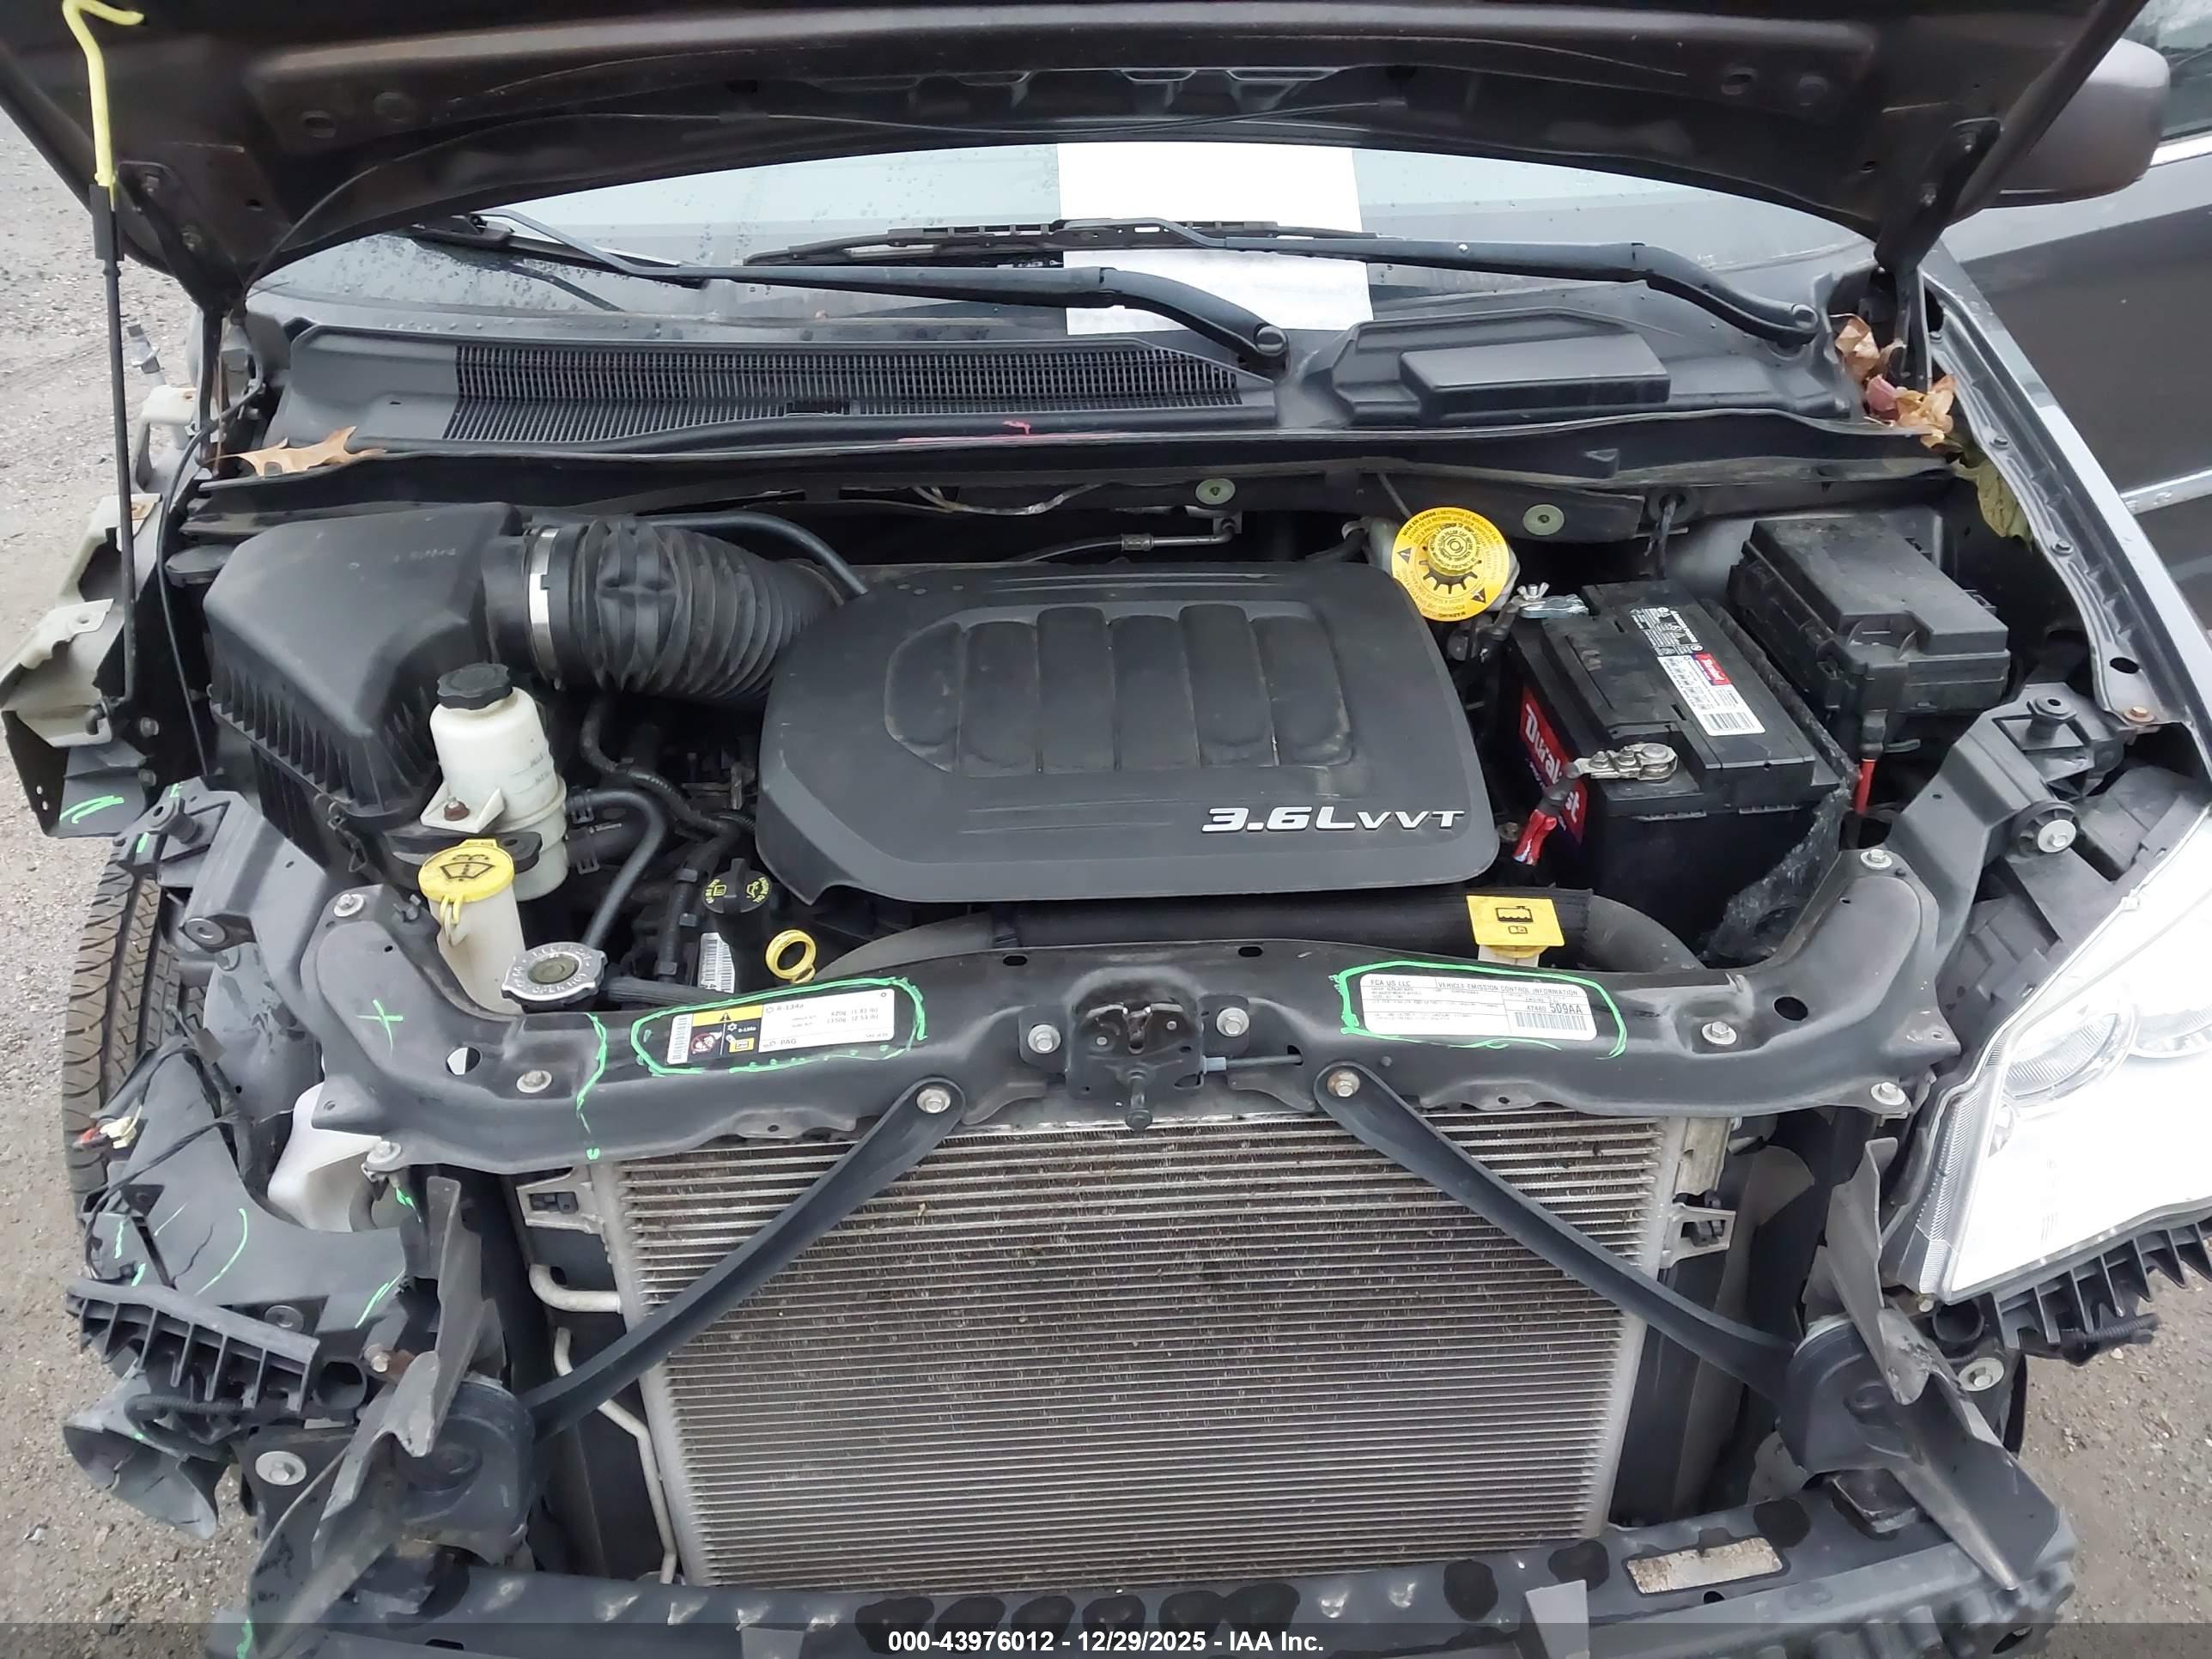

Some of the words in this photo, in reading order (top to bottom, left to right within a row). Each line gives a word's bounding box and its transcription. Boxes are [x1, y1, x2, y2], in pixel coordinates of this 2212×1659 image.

[1202, 805, 1356, 832] 3.6L
[1357, 810, 1466, 830] VVT
[1533, 988, 1578, 996] INFORMATION
[1549, 1003, 1583, 1014] 509AA
[780, 1037, 797, 1046] PAG
